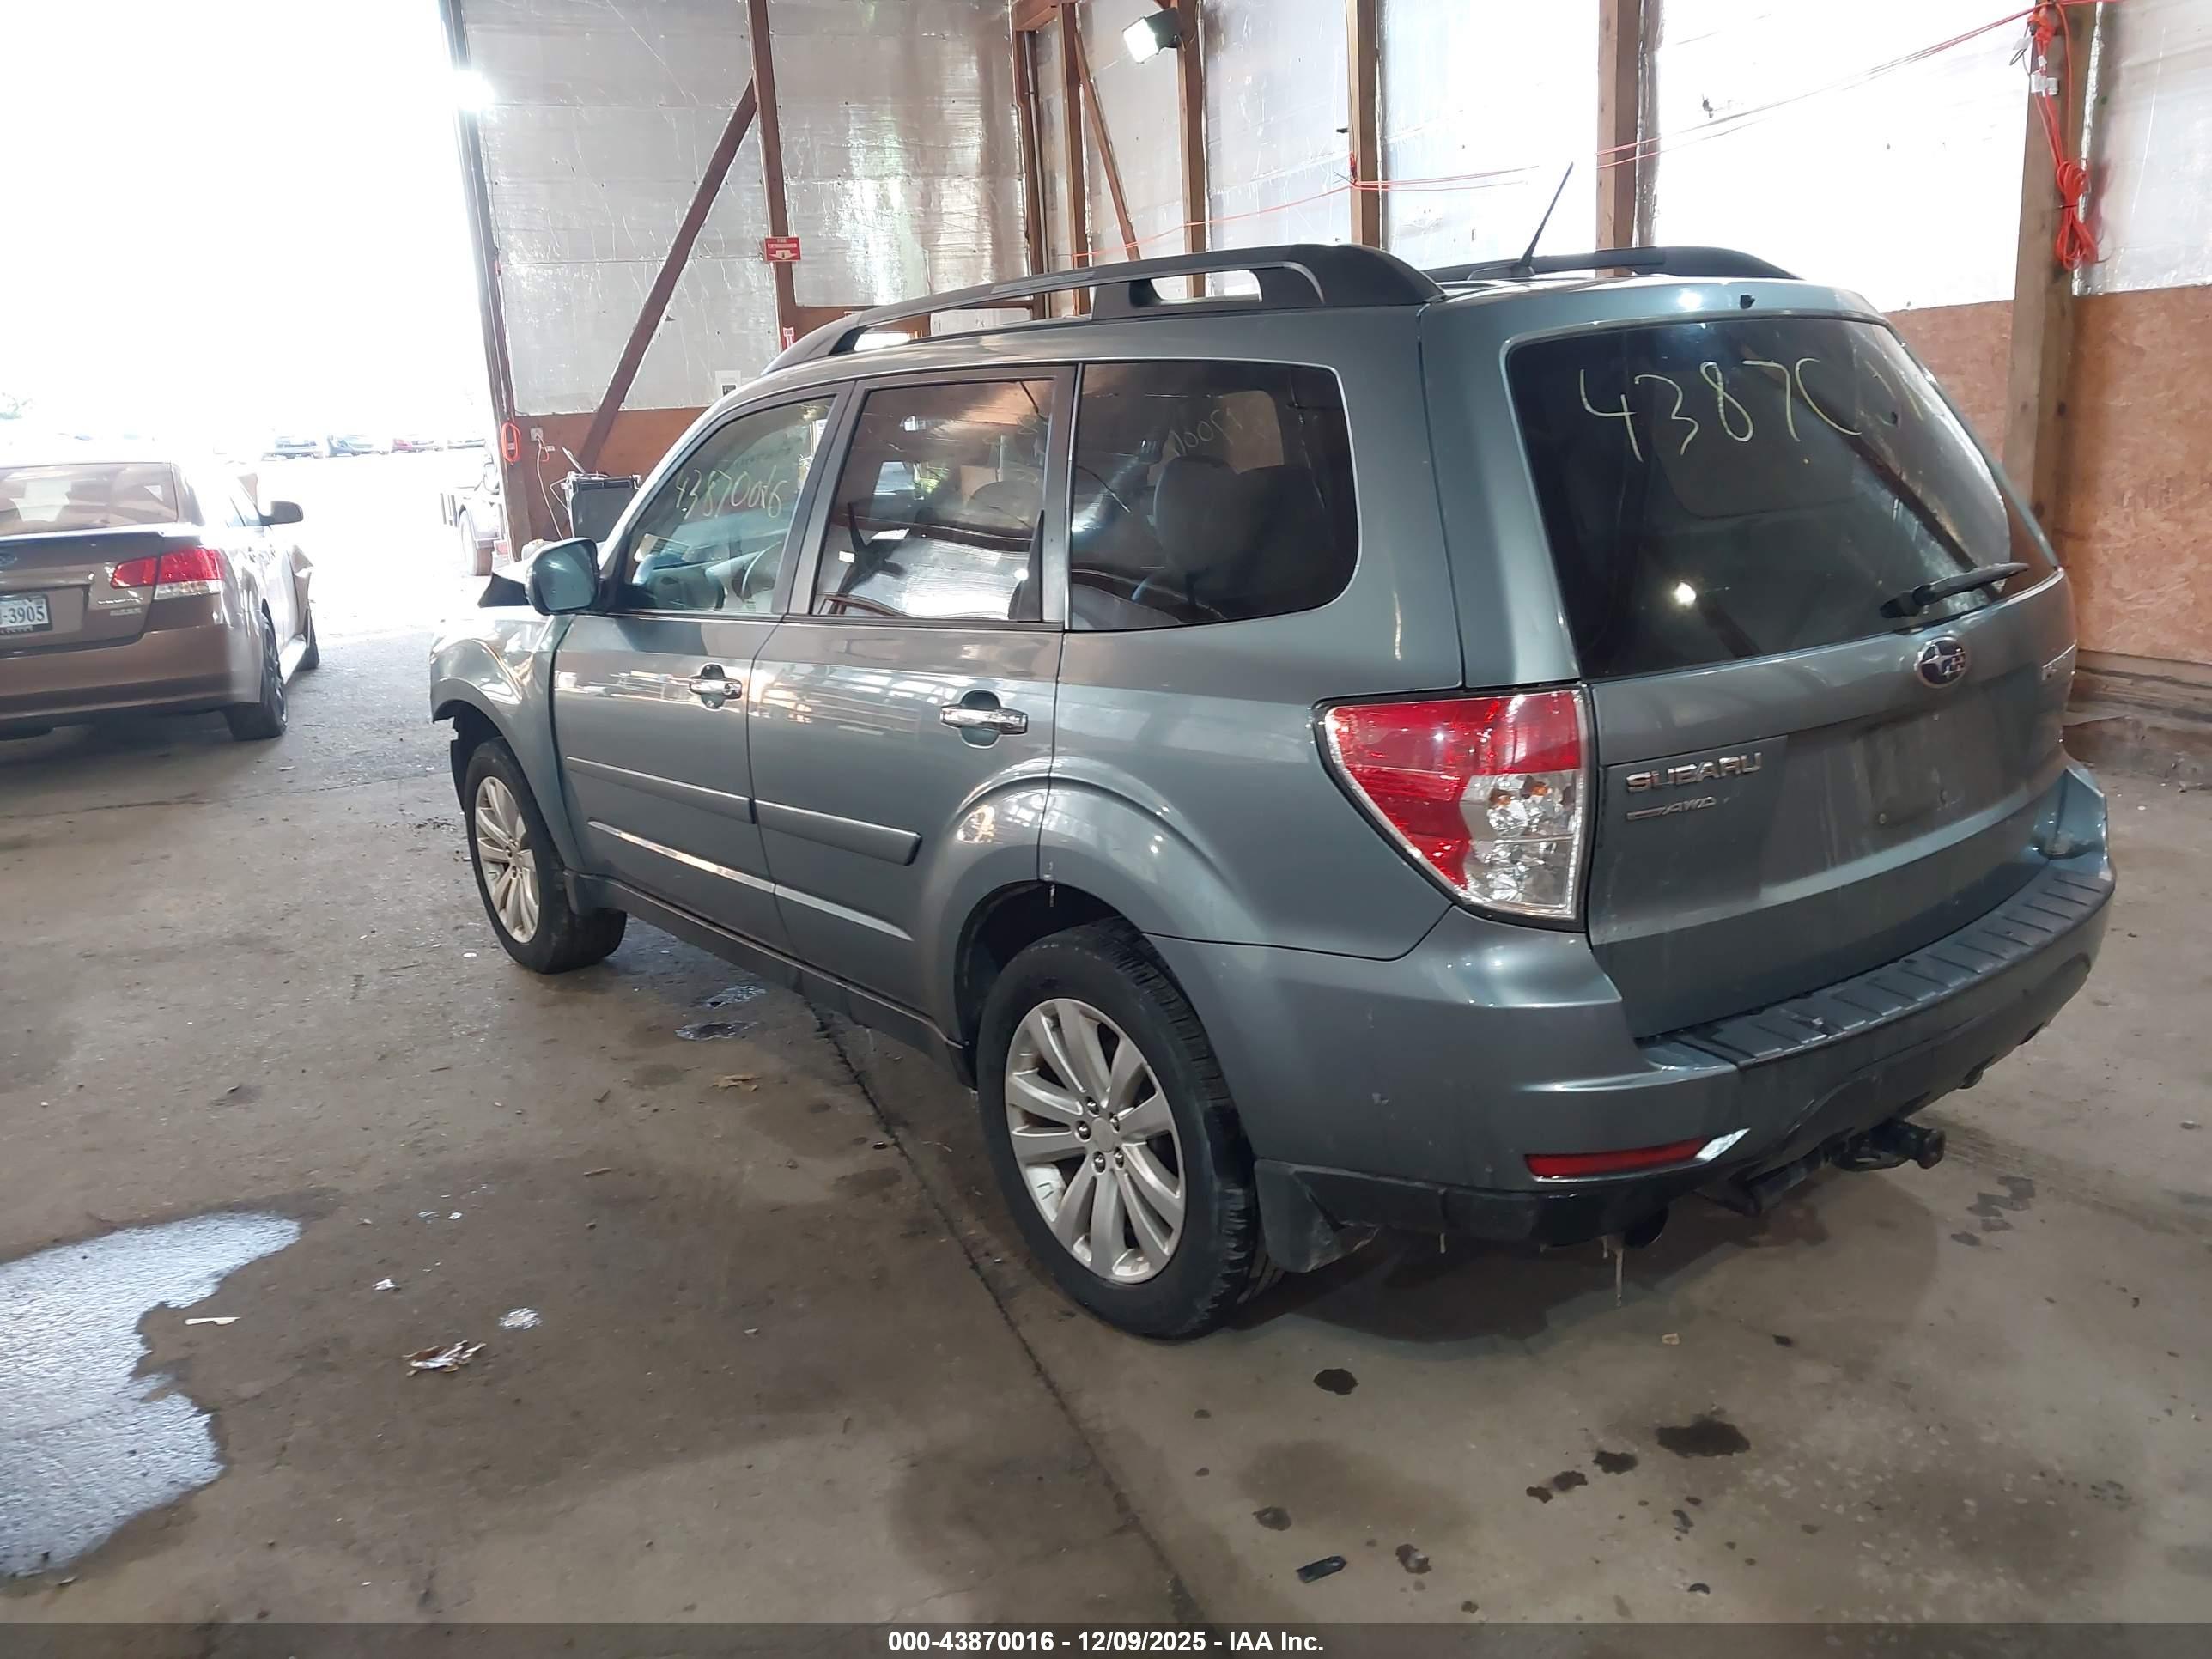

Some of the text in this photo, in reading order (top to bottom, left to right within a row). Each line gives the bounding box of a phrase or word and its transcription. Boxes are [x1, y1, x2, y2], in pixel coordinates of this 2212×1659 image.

[0, 603, 46, 625] -3905
[1626, 752, 1762, 792] SUBARU
[1662, 796, 1717, 816] AWD
